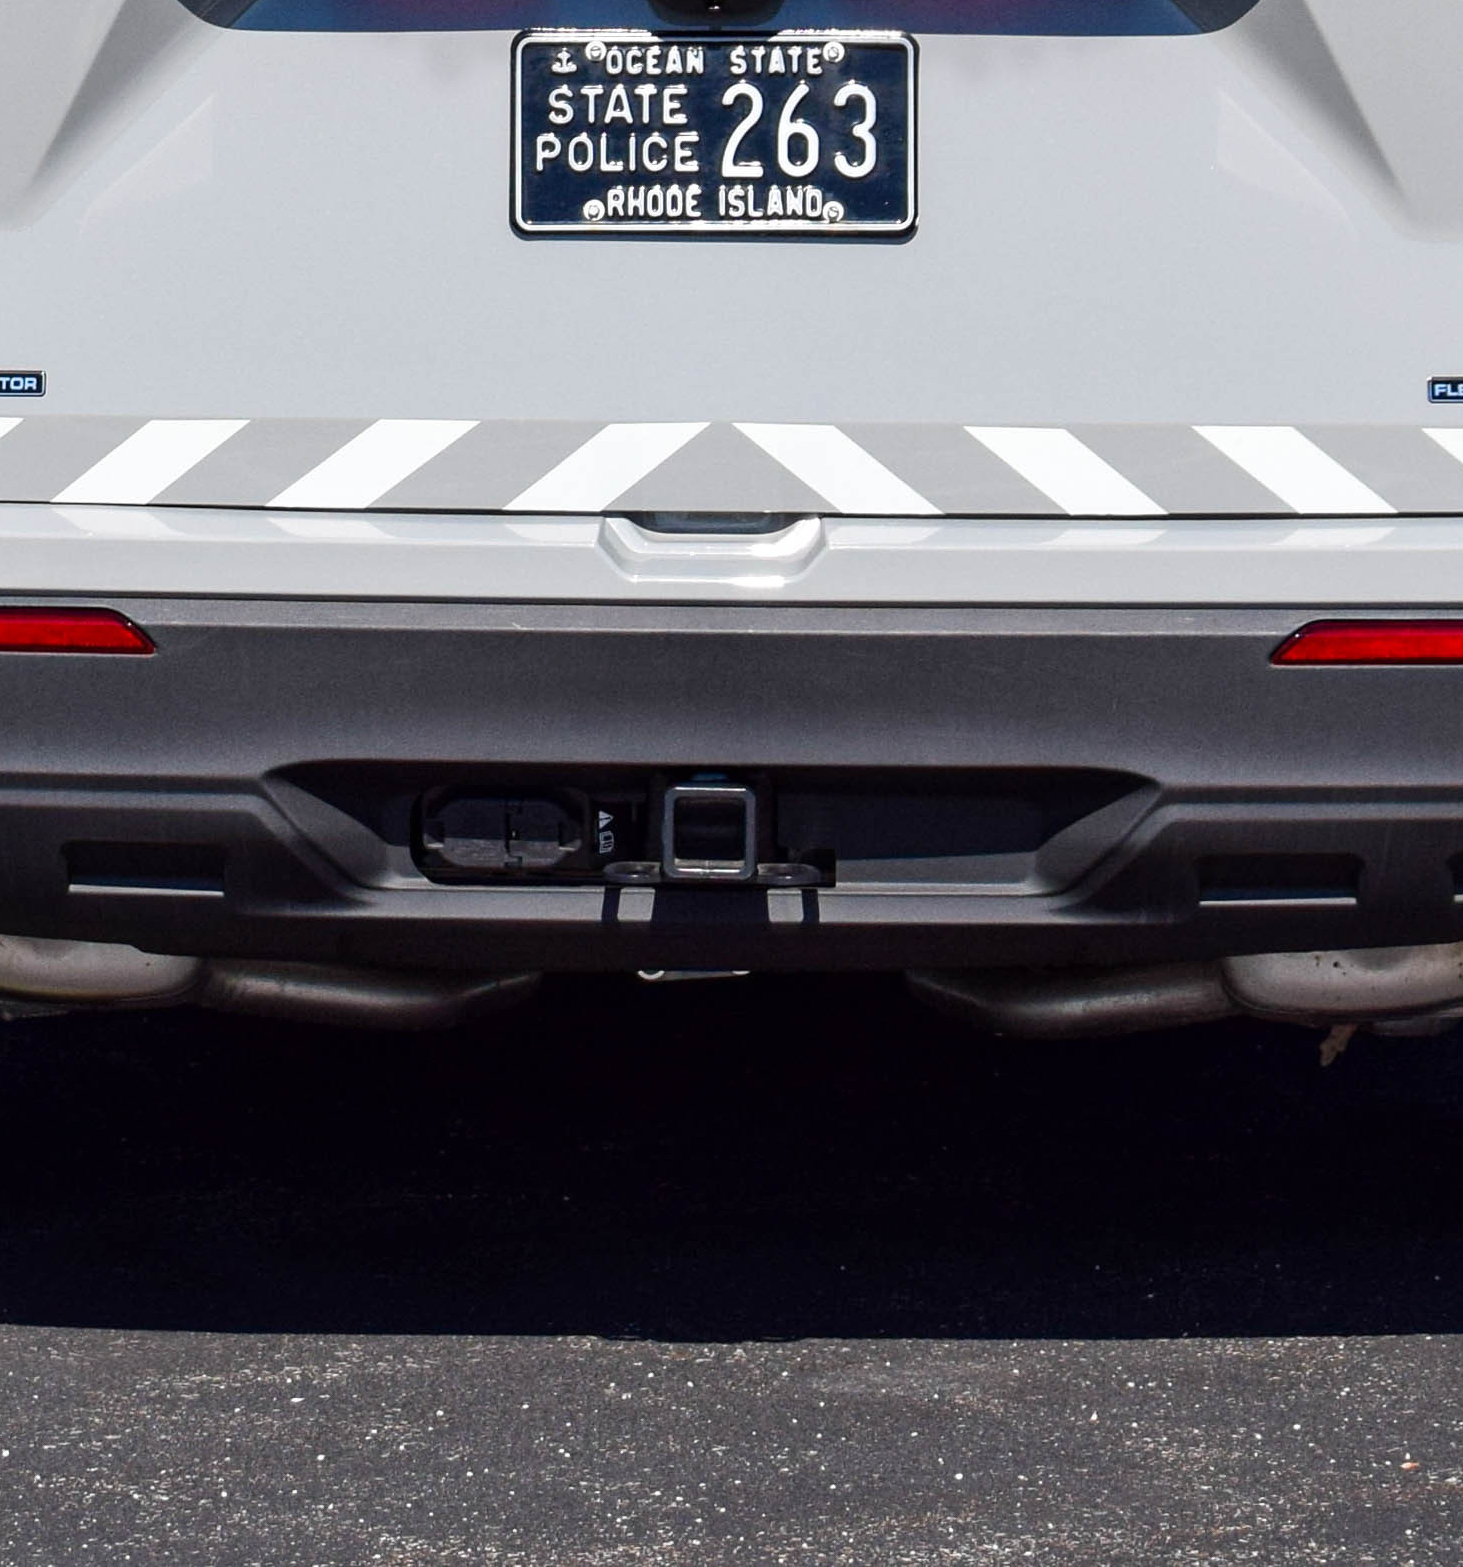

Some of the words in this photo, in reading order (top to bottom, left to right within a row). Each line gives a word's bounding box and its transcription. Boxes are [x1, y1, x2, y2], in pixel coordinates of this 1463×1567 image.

[604, 45, 705, 75] OCEAN
[730, 45, 823, 76] STATE
[547, 83, 688, 125] STATE
[720, 80, 877, 179] 263
[535, 132, 700, 174] POLICE
[606, 184, 702, 218] RHODE
[718, 184, 823, 218] ISLAND
